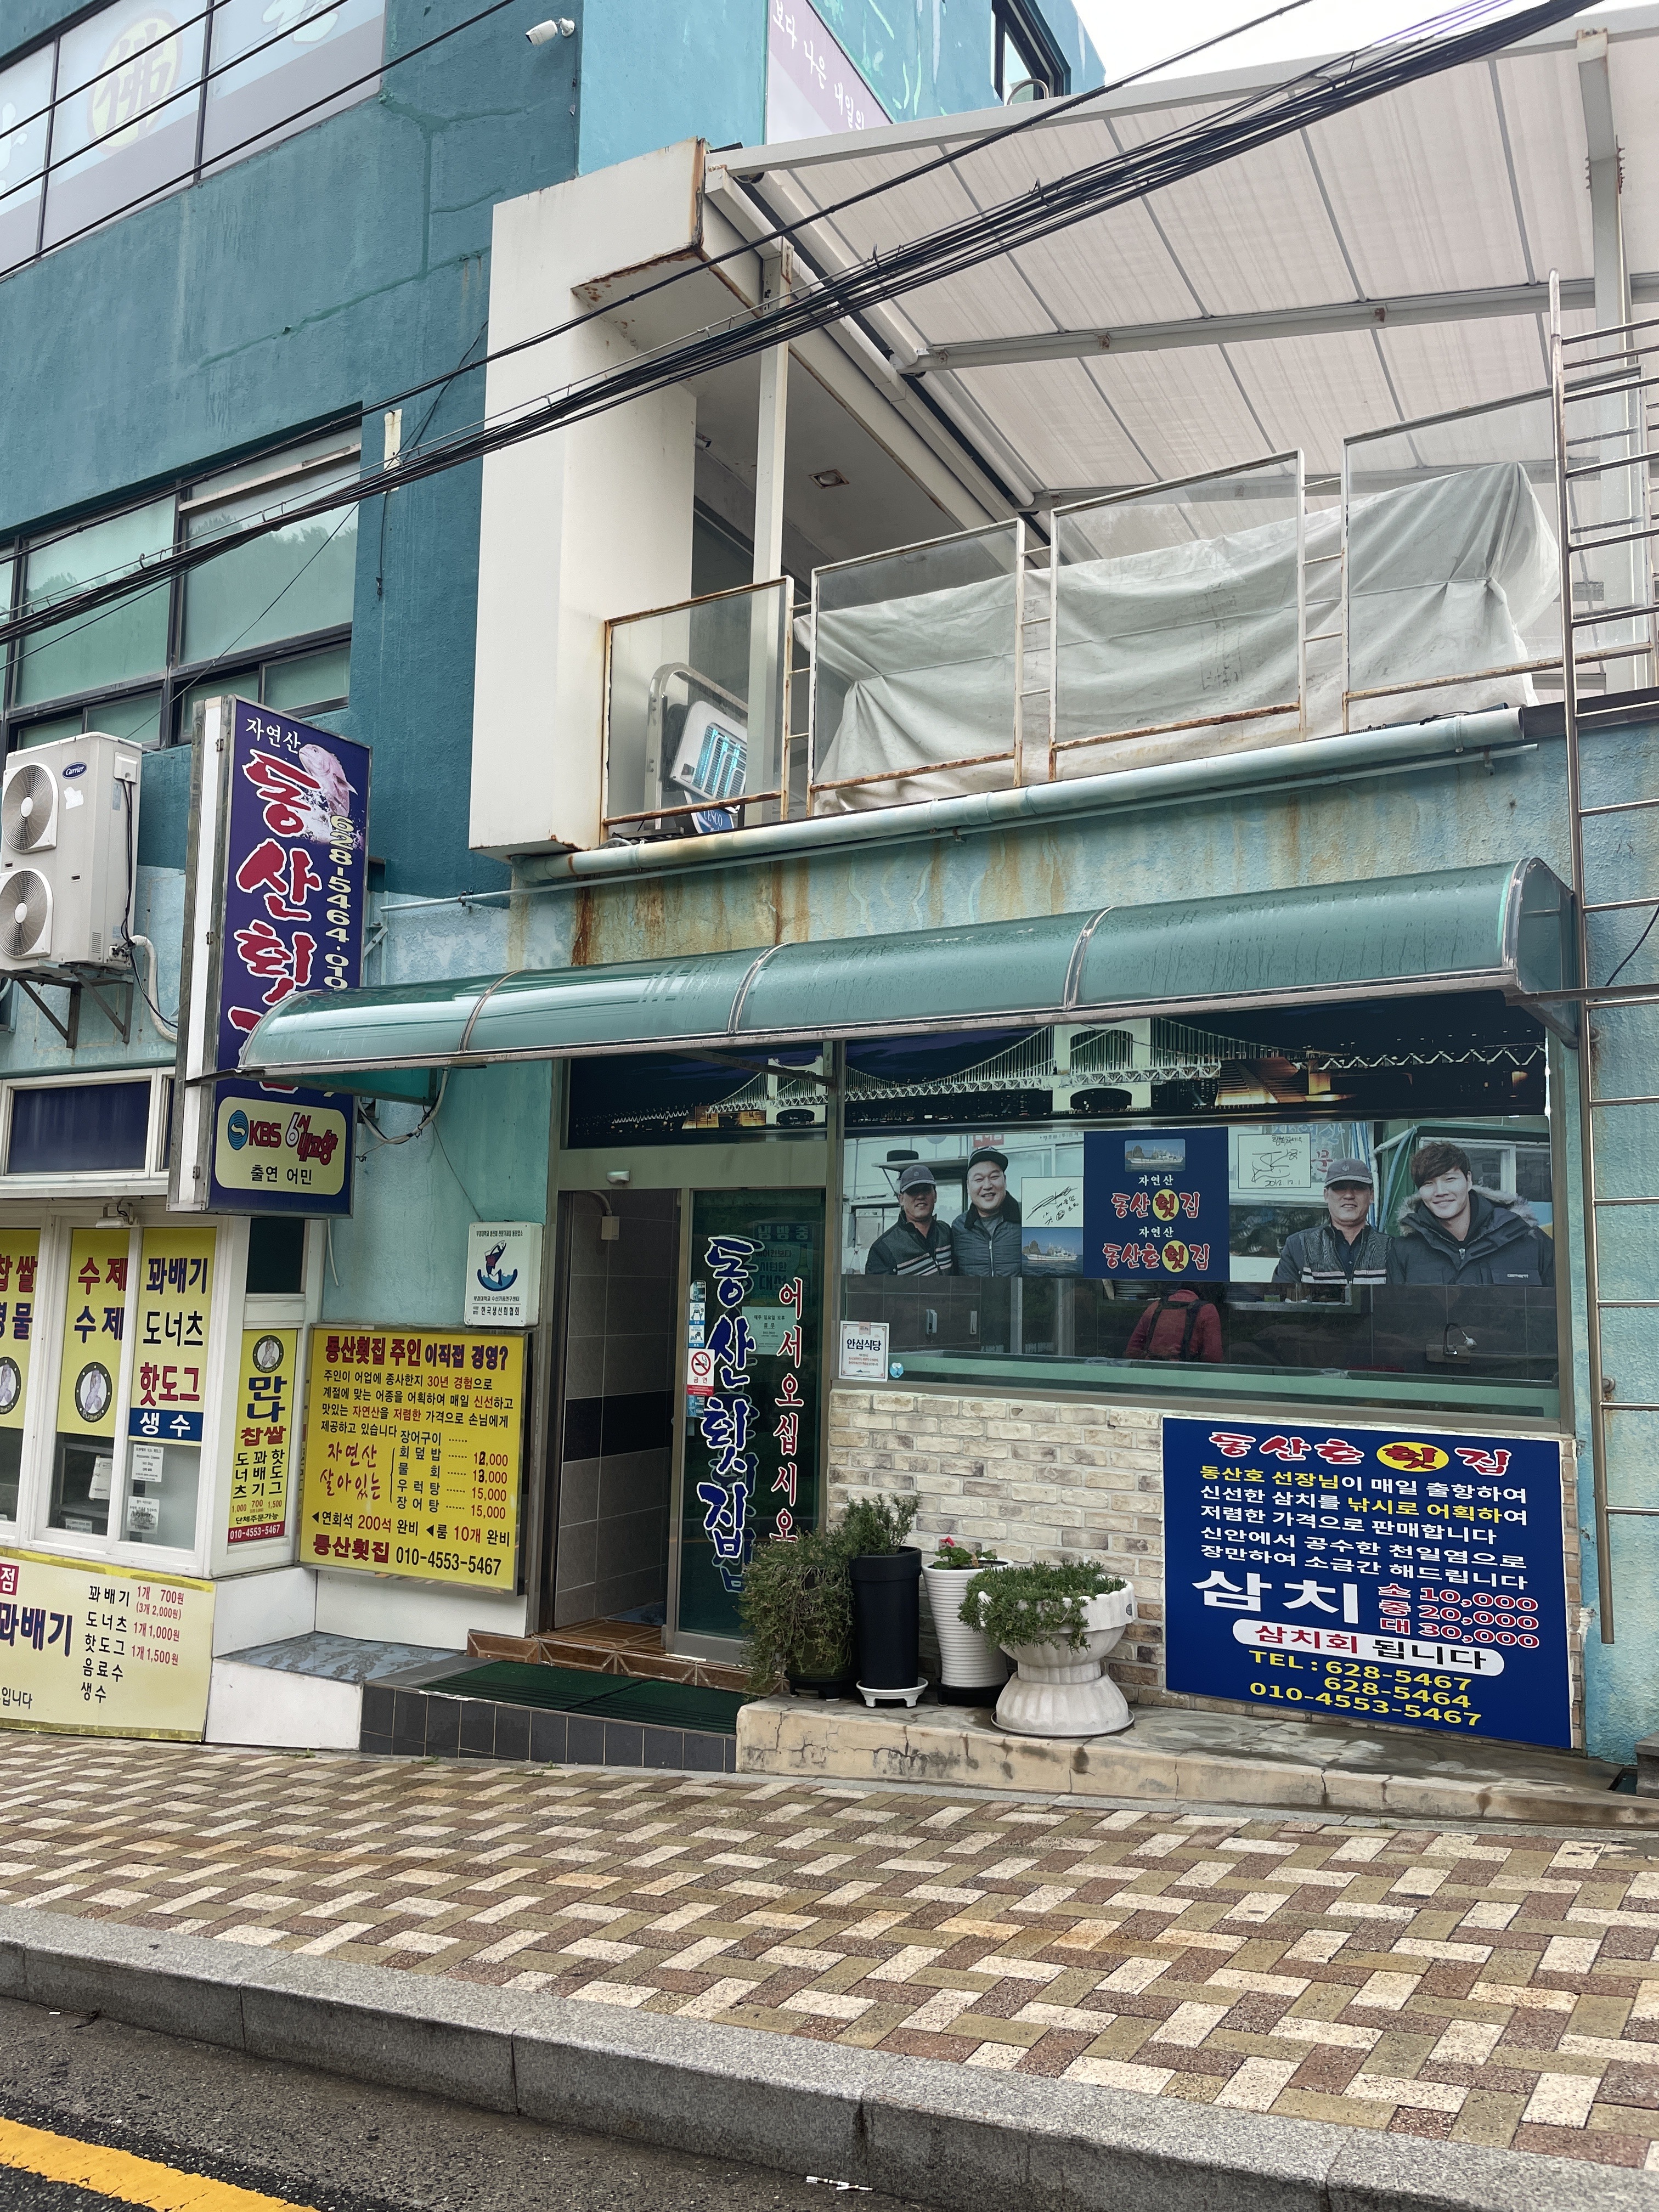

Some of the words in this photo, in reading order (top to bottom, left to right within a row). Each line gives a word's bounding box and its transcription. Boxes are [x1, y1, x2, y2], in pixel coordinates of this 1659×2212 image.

[773, 0, 797, 49] 보다
[804, 40, 827, 89] 나은
[245, 716, 302, 754] 자연산
[65, 765, 84, 775] Carrier
[703, 810, 723, 827] CESCO
[249, 1120, 281, 1148] KBS
[251, 1165, 278, 1182] 출연
[286, 1168, 312, 1185] 어민
[1138, 1175, 1174, 1186] 자연산
[1111, 1191, 1200, 1218] 동산횟집
[1139, 1227, 1174, 1238] 자연산
[760, 1262, 787, 1272] 시원한
[1102, 1242, 1210, 1271] 동산호횟집
[146, 1257, 207, 1295] 꽈배기
[143, 1310, 204, 1347] 도너츠
[325, 1335, 386, 1365] 동산횟집
[390, 1339, 421, 1367] 주인
[471, 1345, 508, 1370] 경영?
[847, 1339, 882, 1351] 안심식당
[140, 1362, 200, 1407] 핫도그
[324, 1370, 350, 1383] 주인이
[355, 1372, 382, 1384] 어업에
[386, 1373, 423, 1386] 종사한지
[427, 1375, 449, 1388] 30년
[454, 1376, 493, 1390] 경험으로
[247, 1375, 287, 1423] 만나
[323, 1387, 349, 1400] 계절에
[354, 1389, 371, 1401] 맞는
[376, 1390, 403, 1403] 어종을
[408, 1392, 445, 1405] 어획하여
[450, 1394, 469, 1407] 매일
[474, 1396, 513, 1409] 신선하고
[696, 1235, 757, 1559] 동산횟집
[770, 1277, 803, 1542] 어서오십시오
[139, 1412, 191, 1438] 생수
[321, 1420, 356, 1434] 제공하고
[361, 1423, 397, 1437] 있습니다
[322, 1403, 348, 1415] 맛있는
[352, 1406, 389, 1419] 자연산을
[393, 1408, 421, 1422] 저렴한
[425, 1410, 463, 1425] 가격으로
[469, 1413, 508, 1428] 손님에게
[240, 1426, 286, 1447] 찹쌀
[400, 1430, 442, 1445] 장어구이
[328, 1441, 377, 1468] 자연산
[320, 1468, 381, 1500] 살아있는
[472, 1487, 506, 1502] 15,000
[1199, 1465, 1265, 1483] 동산호
[1272, 1470, 1363, 1492] 선장님이
[1371, 1476, 1418, 1495] 매일
[1425, 1481, 1527, 1505] 출항하여
[232, 1504, 247, 1513] 1,000
[251, 1499, 263, 1508] 700
[268, 1499, 282, 1509] 1,500
[235, 1513, 279, 1525] 단체주문가능
[471, 1504, 506, 1519] 15,000
[1200, 1486, 1265, 1504] 신선한
[1274, 1489, 1339, 1511] 삼치를
[1347, 1496, 1418, 1517] 낚시로
[1426, 1503, 1528, 1526] 어획하여
[230, 1524, 280, 1540] 010-4553-5467
[322, 1511, 353, 1528] 연회석
[358, 1515, 392, 1533] 200석
[397, 1520, 419, 1536] 완비
[437, 1524, 447, 1539] 룸
[454, 1526, 481, 1543] 10개
[487, 1530, 510, 1547] 완비
[1200, 1505, 1265, 1523] 저렴한
[1273, 1510, 1364, 1533] 가격으로
[1372, 1517, 1497, 1545] 판매합니다
[313, 1533, 390, 1563] 동산횟집
[396, 1546, 501, 1576] 010-4553-5467
[1200, 1525, 1295, 1548] 신안에서
[1304, 1534, 1381, 1557] 공수한
[1389, 1542, 1527, 1570] 천일염으로
[1200, 1544, 1296, 1567] 장만하여
[1304, 1555, 1382, 1577] 소금간
[1389, 1562, 1528, 1590] 해드립니다
[88, 1585, 130, 1606] 꽈배기
[137, 1586, 150, 1600] 1개
[161, 1589, 184, 1605] 700원
[1191, 1570, 1359, 1623] 삼치
[1377, 1583, 1412, 1599] 소
[1419, 1587, 1539, 1612] 10,000
[136, 1603, 150, 1615] (3개
[152, 1605, 182, 1620] 2,000원)
[1378, 1599, 1412, 1616] 중
[1418, 1604, 1539, 1630] 20,000
[86, 1612, 127, 1633] 도너츠
[133, 1622, 146, 1637] 1개
[149, 1625, 180, 1641] 1,000원
[1379, 1617, 1411, 1636] 대
[1418, 1622, 1541, 1650] 30,000
[84, 1633, 125, 1656] 핫도그
[131, 1645, 144, 1660] 1개
[146, 1647, 178, 1666] 1,500원
[1254, 1624, 1358, 1655] 삼치회
[1372, 1640, 1487, 1671] 됩니다
[82, 1658, 123, 1682] 음료수
[1325, 1660, 1473, 1691] 628-5467
[81, 1682, 106, 1703] 생수
[1249, 1681, 1483, 1726] 010-4553-5467
[1324, 1678, 1472, 1709] 628-5464
